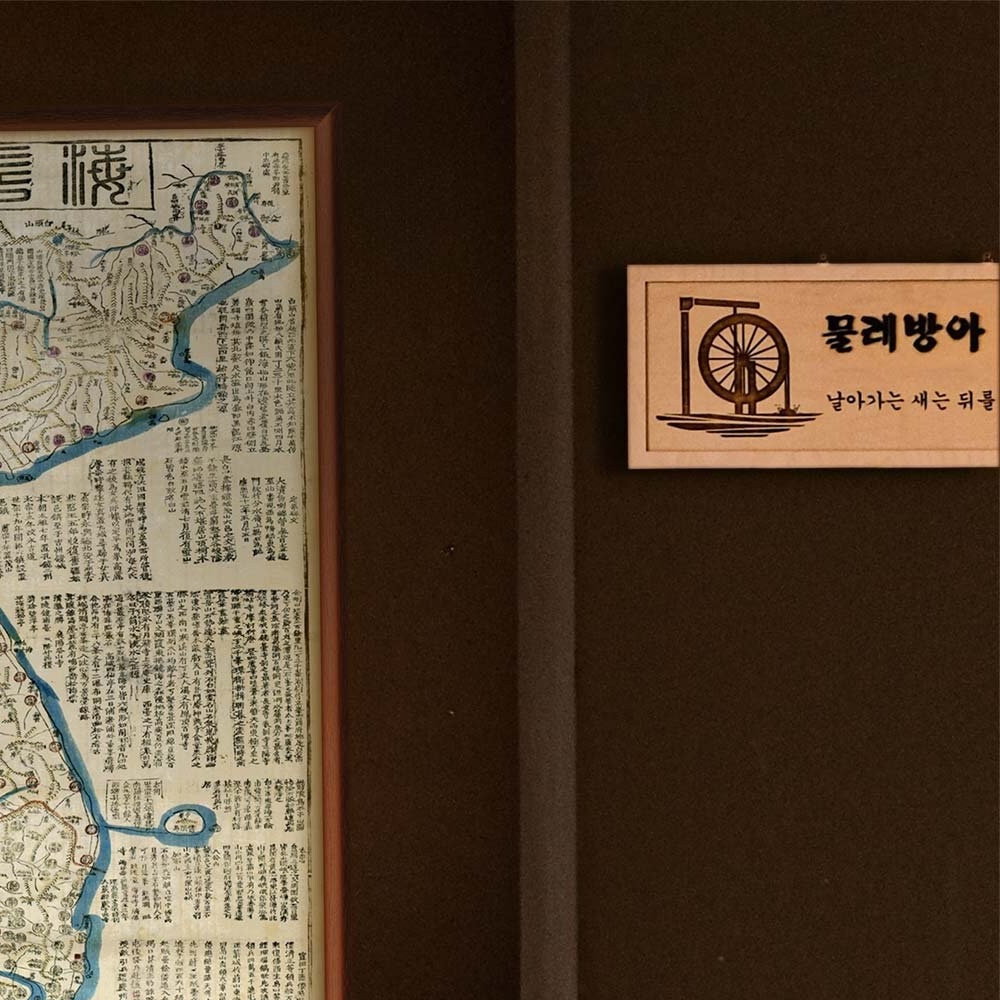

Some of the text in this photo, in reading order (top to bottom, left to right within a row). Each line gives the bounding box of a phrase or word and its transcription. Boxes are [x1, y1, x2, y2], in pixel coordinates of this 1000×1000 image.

[821, 312, 985, 353] 물레방아
[826, 390, 996, 411] 날아가는 새는 뒤를
